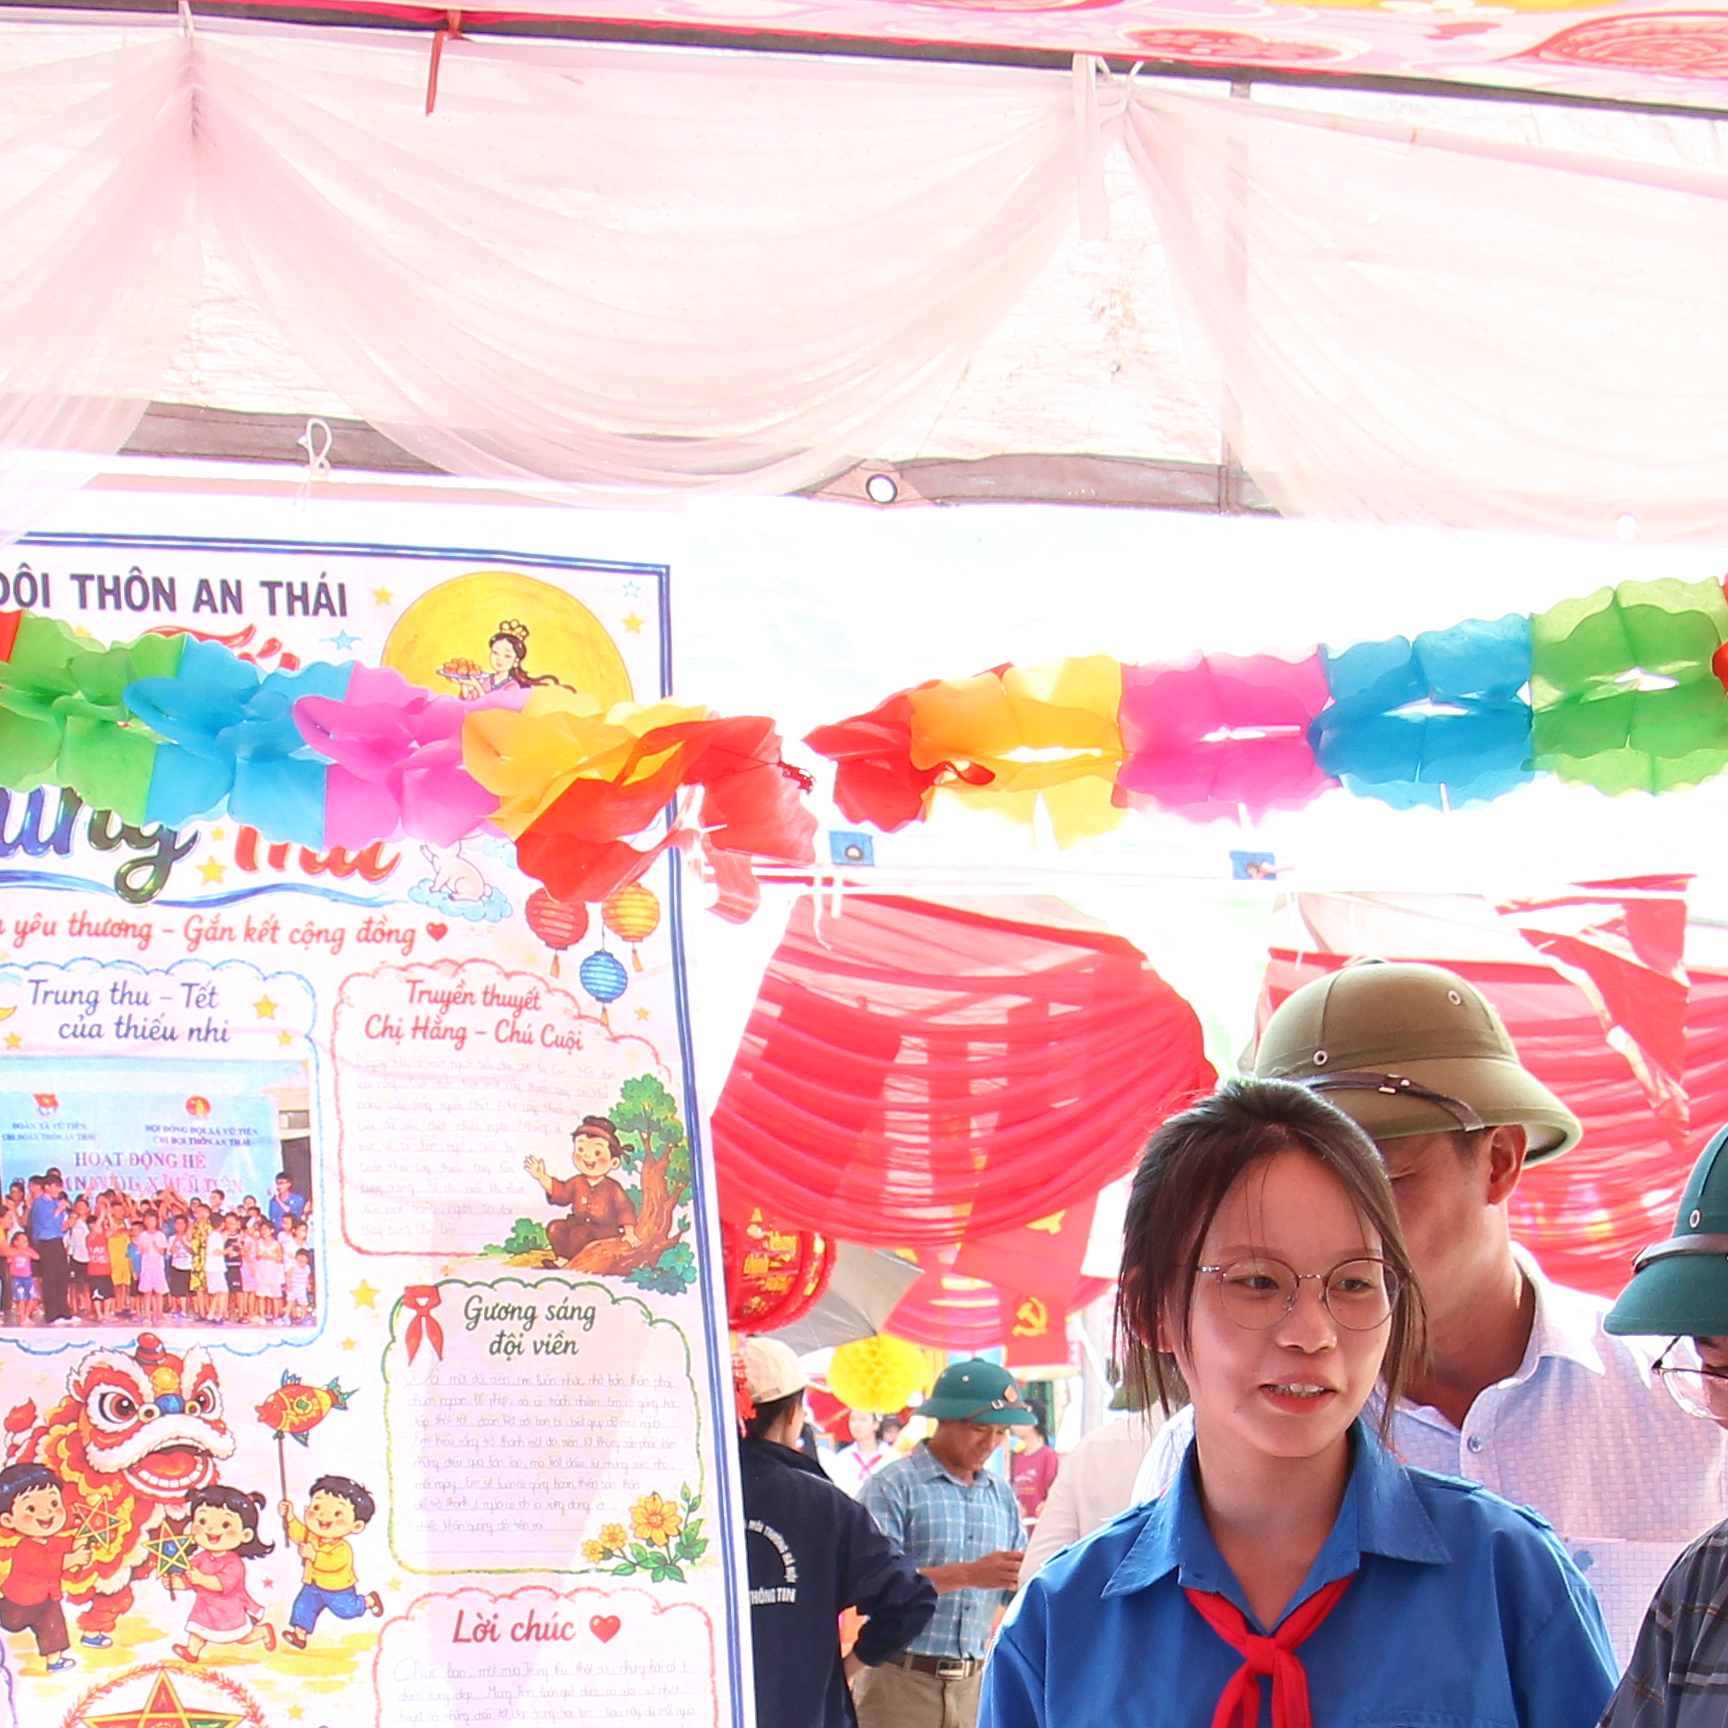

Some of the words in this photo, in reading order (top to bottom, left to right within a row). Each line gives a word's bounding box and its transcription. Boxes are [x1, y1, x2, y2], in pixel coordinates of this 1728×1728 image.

[70, 565, 177, 613] THÔN
[193, 577, 243, 616] AN
[260, 571, 348, 617] THÁI
[12, 912, 57, 949] yêu
[68, 909, 153, 951] thương
[183, 912, 237, 953] Gắn
[242, 914, 281, 944] kết
[288, 920, 346, 956] cộng
[355, 914, 417, 957] đồng
[28, 980, 101, 1011] Trung
[109, 980, 151, 1006] thu
[180, 980, 219, 1010] Tết
[405, 979, 476, 1015] Truyền
[482, 984, 542, 1018] thuyết
[58, 1014, 103, 1041] của
[113, 1010, 178, 1042] thiếu
[187, 1017, 230, 1044] nhi
[365, 1013, 404, 1046] Chị
[411, 1013, 468, 1051] Hằng
[494, 1018, 536, 1045] Chú
[541, 1023, 584, 1056] Cuội
[75, 1152, 125, 1171] HOẠT
[128, 1151, 177, 1171] ĐỘNG
[464, 1294, 538, 1332] Gương
[545, 1296, 597, 1332] sáng
[488, 1329, 525, 1362] đội
[452, 1608, 501, 1643] Lời
[510, 1608, 576, 1642] chúc
